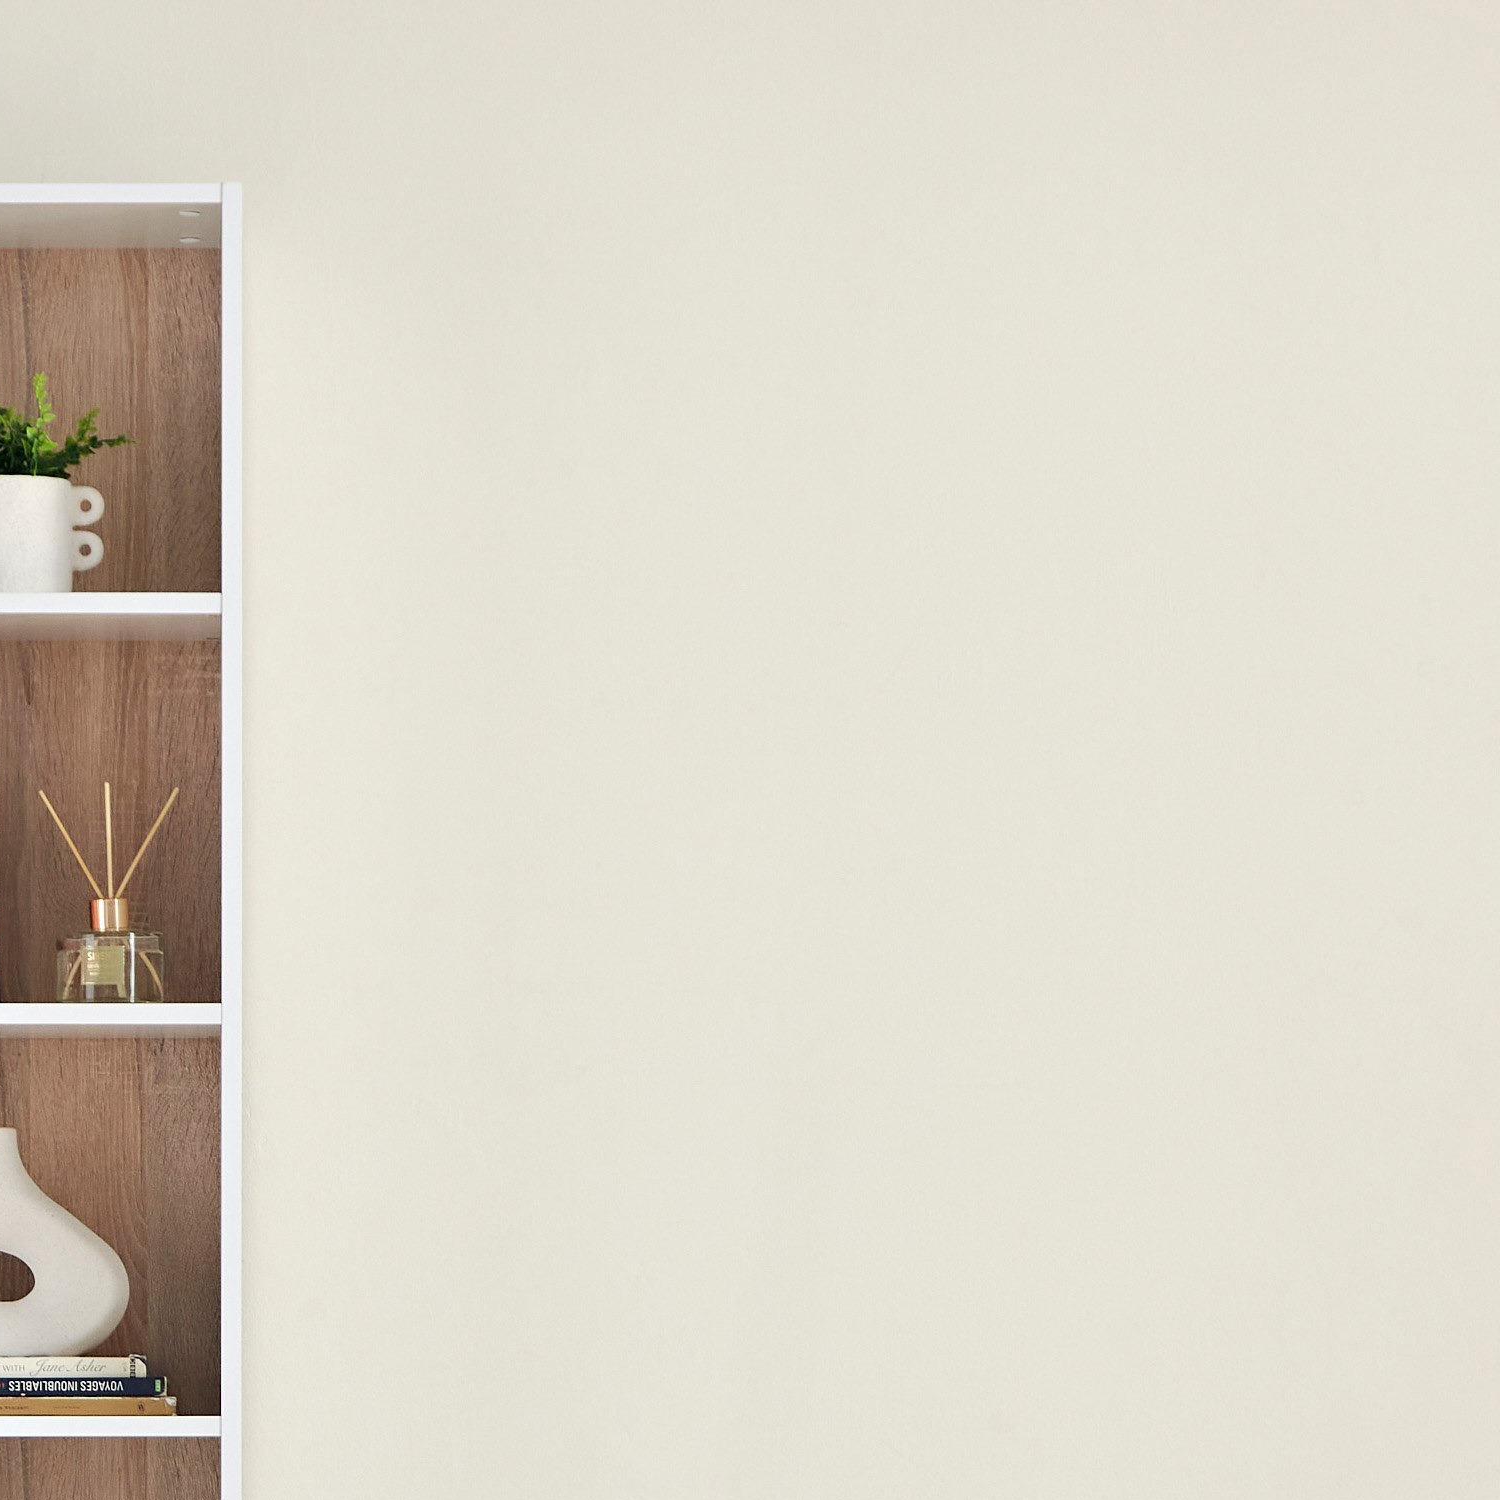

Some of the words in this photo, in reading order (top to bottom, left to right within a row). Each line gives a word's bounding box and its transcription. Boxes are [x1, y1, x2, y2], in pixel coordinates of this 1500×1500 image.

[3, 1363, 25, 1372] WITH
[29, 1359, 65, 1376] Jane
[66, 1359, 106, 1372] Asher
[8, 1381, 78, 1391] INOUBLIABLES
[80, 1380, 124, 1391] VOYAGES
